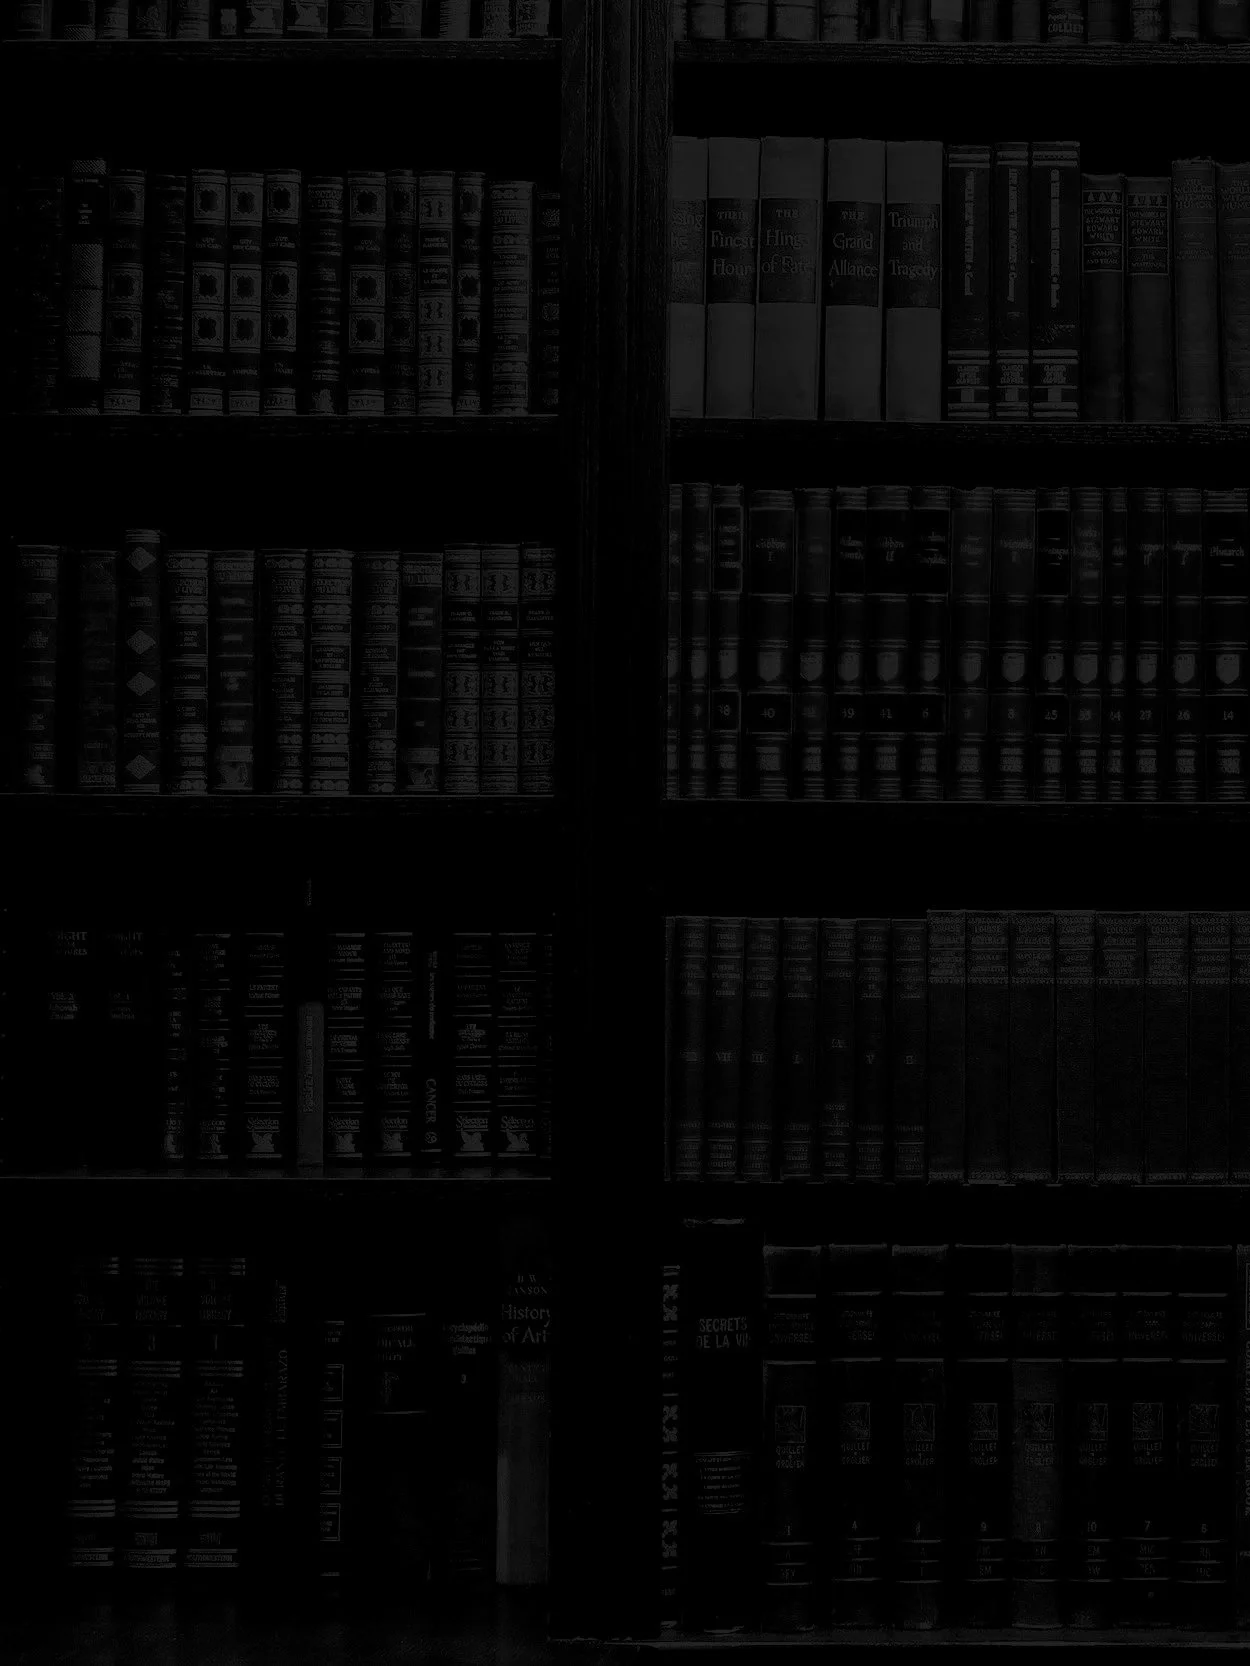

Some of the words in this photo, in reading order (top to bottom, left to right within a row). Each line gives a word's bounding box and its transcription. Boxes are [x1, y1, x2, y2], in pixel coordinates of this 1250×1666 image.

[888, 210, 940, 232] Triumph
[832, 232, 874, 251] Grand
[902, 236, 924, 251] and
[711, 257, 755, 277] Hour
[761, 254, 780, 274] of
[828, 259, 879, 278] Alliance
[888, 258, 938, 281] Tragedy
[424, 1078, 437, 1124] CANCER
[501, 1304, 552, 1328] History
[699, 1316, 749, 1333] SECRETS
[503, 1327, 520, 1343] of
[521, 1326, 551, 1344] Art
[696, 1335, 712, 1349] DE
[716, 1335, 731, 1349] LA
